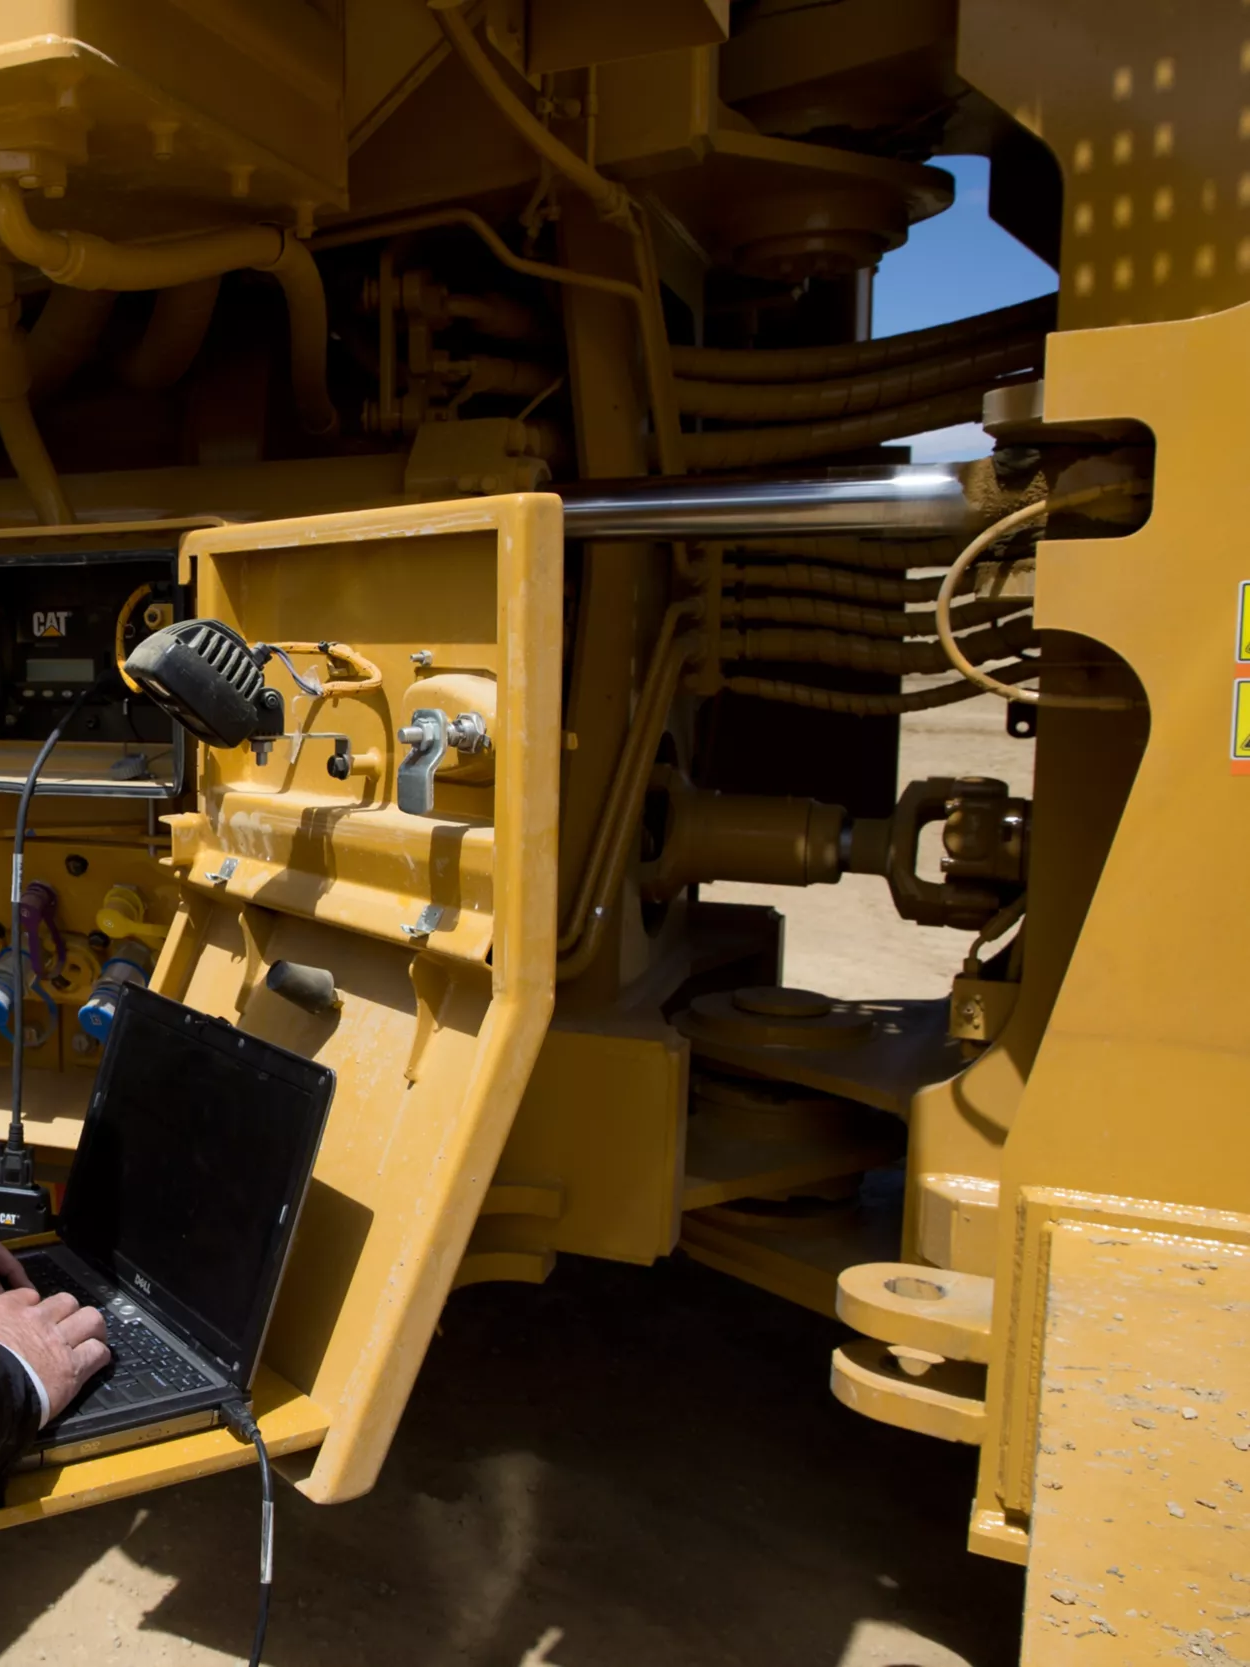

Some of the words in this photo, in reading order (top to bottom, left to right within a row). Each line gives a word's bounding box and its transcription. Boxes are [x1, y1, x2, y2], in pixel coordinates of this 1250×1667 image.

[33, 611, 68, 637] CAT
[0, 1212, 16, 1225] CAT
[134, 1273, 151, 1294] DELL
